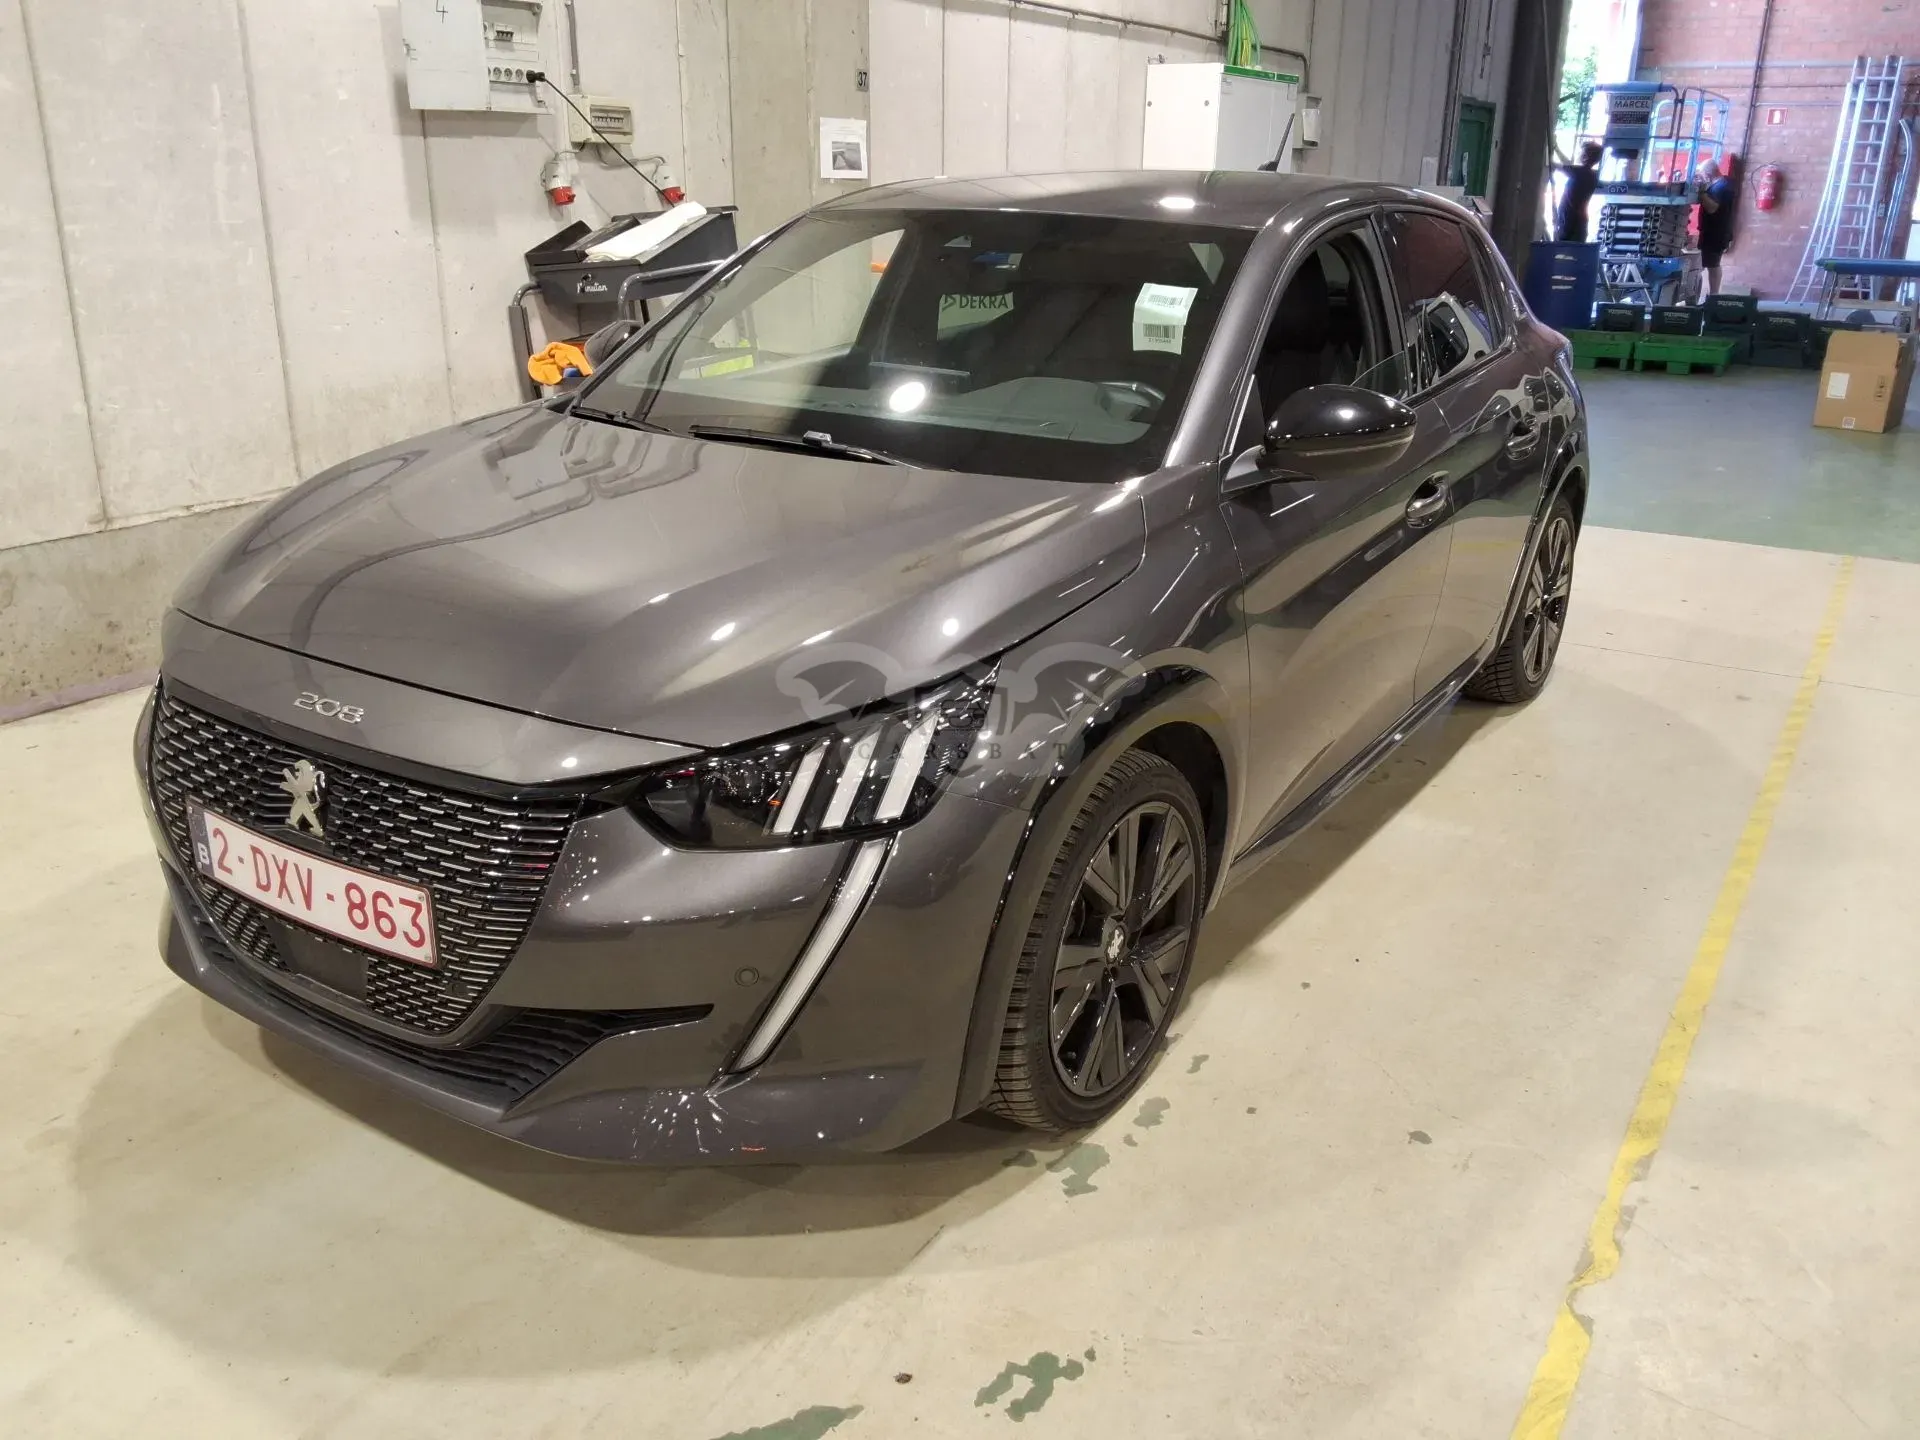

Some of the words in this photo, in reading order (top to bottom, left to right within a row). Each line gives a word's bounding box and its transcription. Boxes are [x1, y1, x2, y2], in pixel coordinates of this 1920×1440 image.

[857, 71, 868, 87] 37
[1614, 100, 1650, 109] MARCEL
[959, 294, 1009, 309] DEKRA
[293, 691, 365, 724] 208
[198, 843, 210, 864] B
[212, 827, 427, 948] 2-DXV-863
